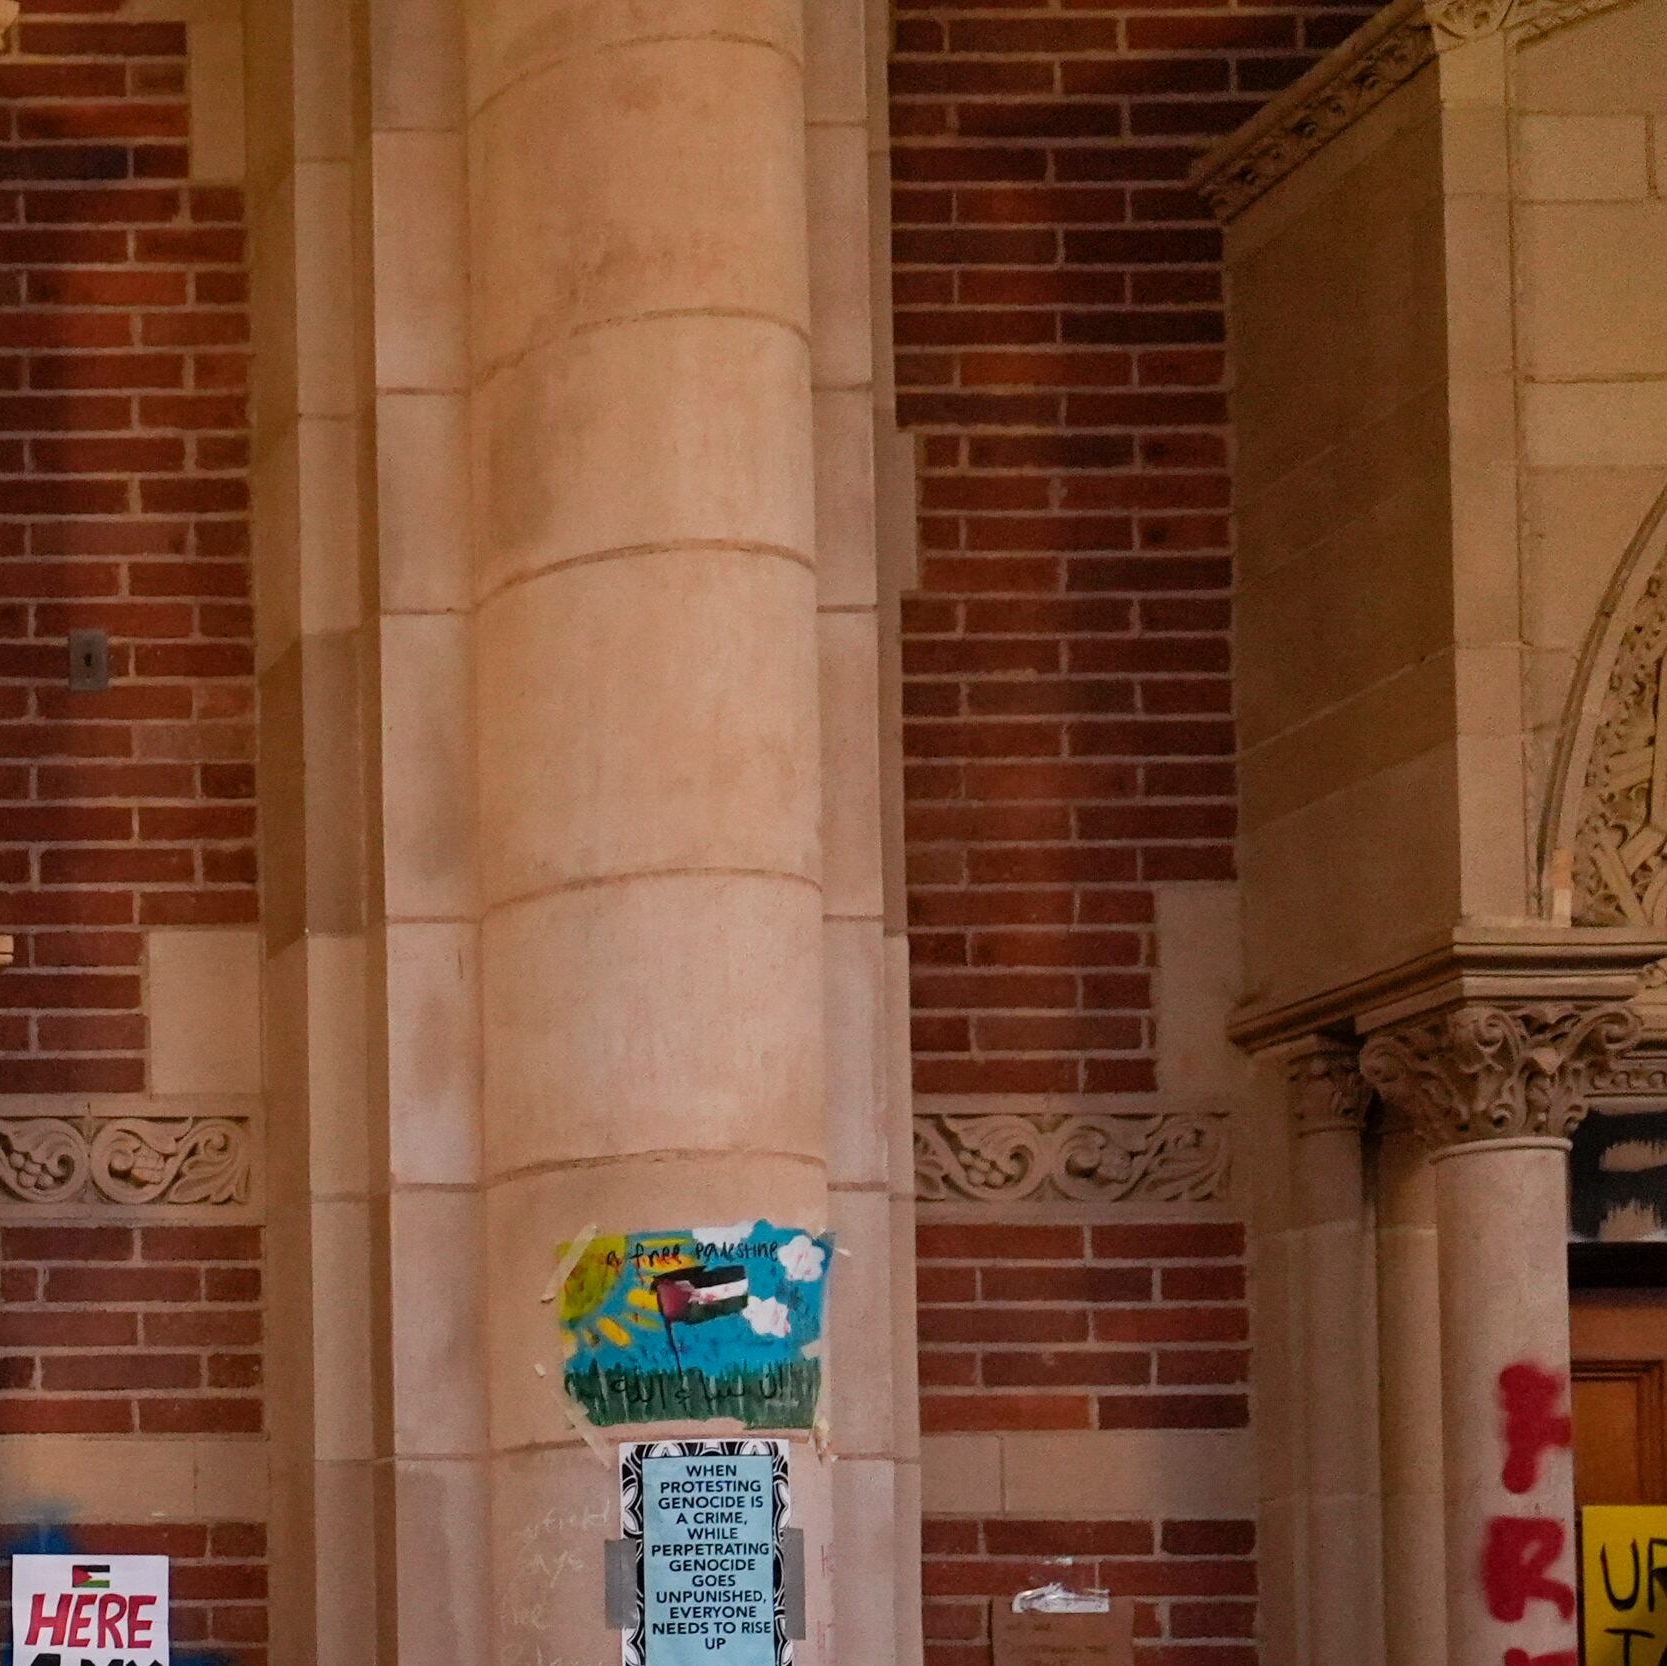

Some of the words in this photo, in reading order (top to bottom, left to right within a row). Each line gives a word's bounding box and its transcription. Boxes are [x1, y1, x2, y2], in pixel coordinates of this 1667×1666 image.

[686, 1464, 737, 1478] WHEN
[660, 1480, 761, 1493] PROTESTING
[657, 1496, 748, 1510] GENOCIDE
[751, 1496, 763, 1508] IS
[676, 1513, 689, 1525] A
[694, 1511, 748, 1526] CRIME,
[687, 1528, 738, 1540] WHILE
[651, 1543, 770, 1557] PERPETRATING
[668, 1559, 756, 1573] GENOCIDE
[692, 1574, 736, 1588] GOES
[656, 1590, 767, 1604] UNPUNISHED,
[669, 1606, 757, 1619] EVERYONE
[24, 1592, 157, 1650] HERE
[652, 1622, 711, 1635] NEEDS
[714, 1622, 738, 1635] TO
[742, 1621, 771, 1634] RISE
[705, 1637, 726, 1650] UP
